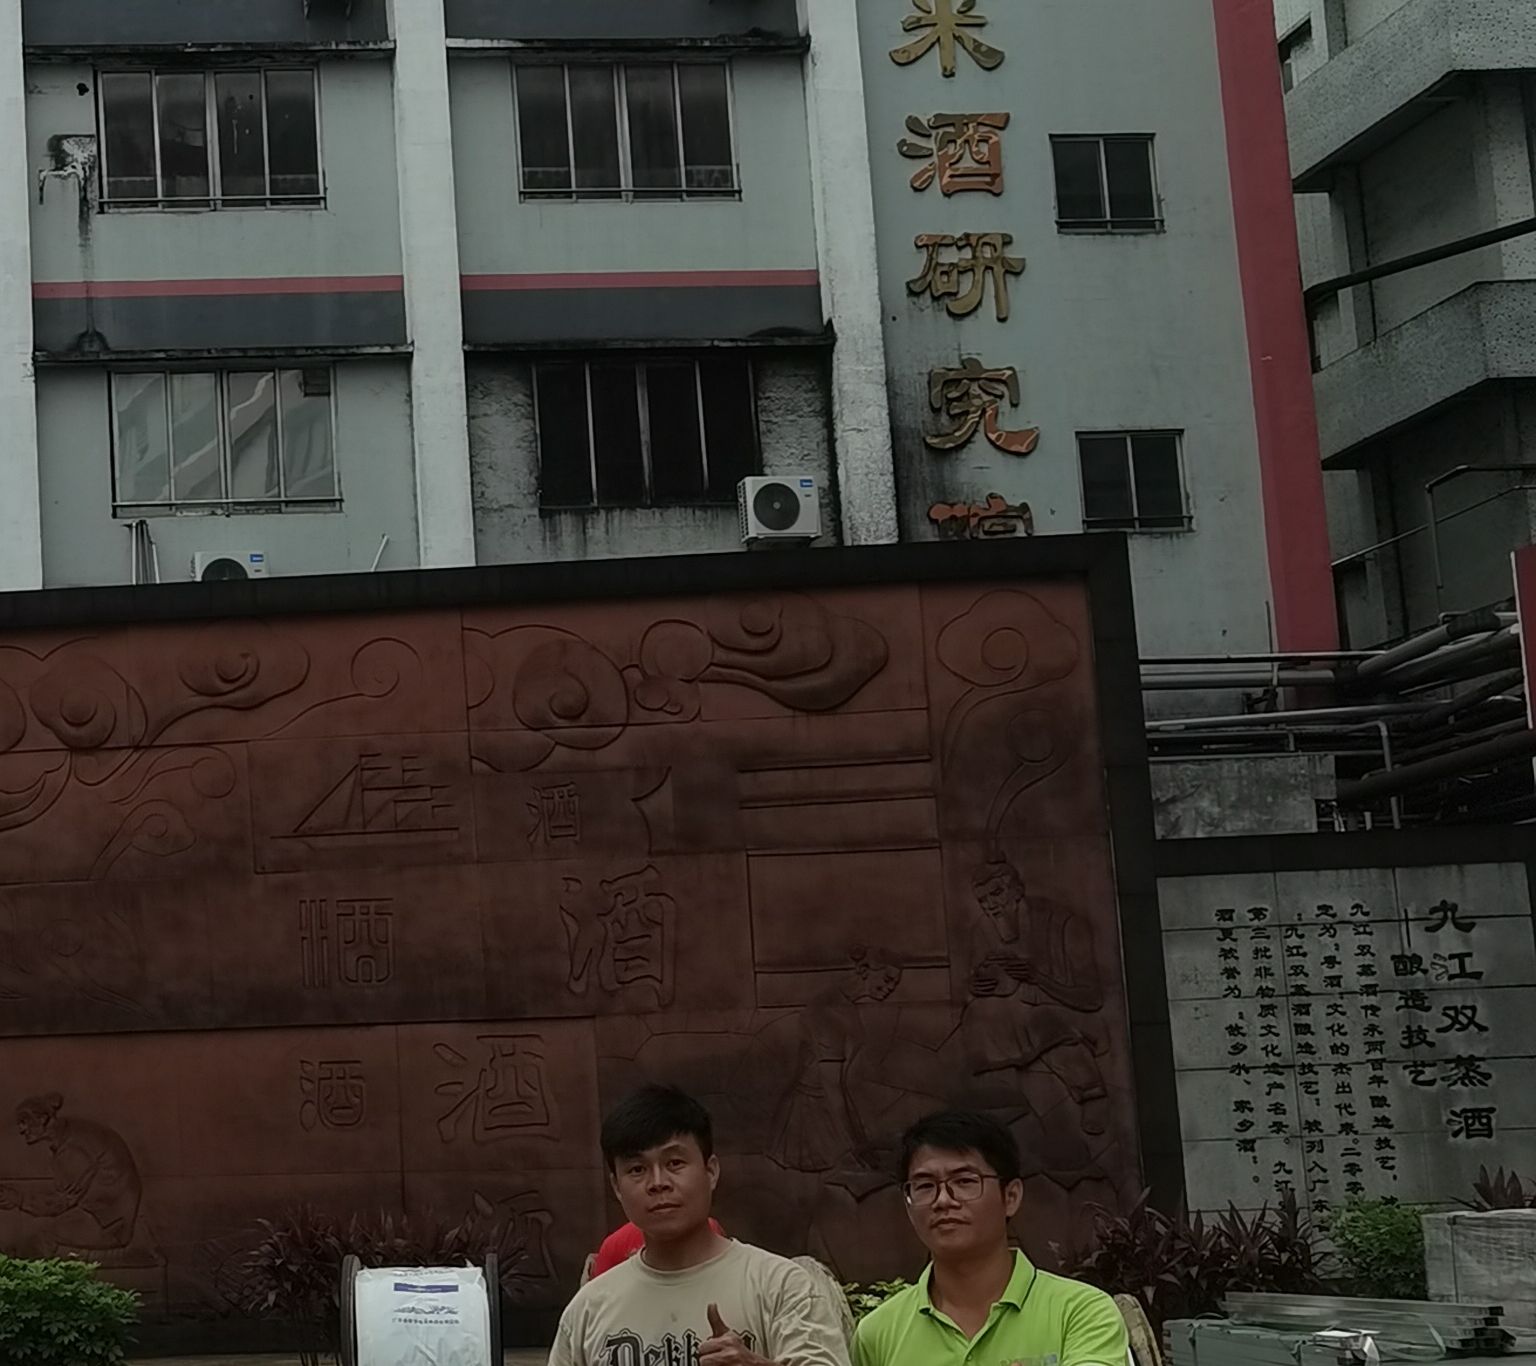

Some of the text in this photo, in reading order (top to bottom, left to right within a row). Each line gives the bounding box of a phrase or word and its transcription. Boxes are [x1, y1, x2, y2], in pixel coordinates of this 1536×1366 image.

[1424, 899, 1497, 1140] 九江双蒸酒
